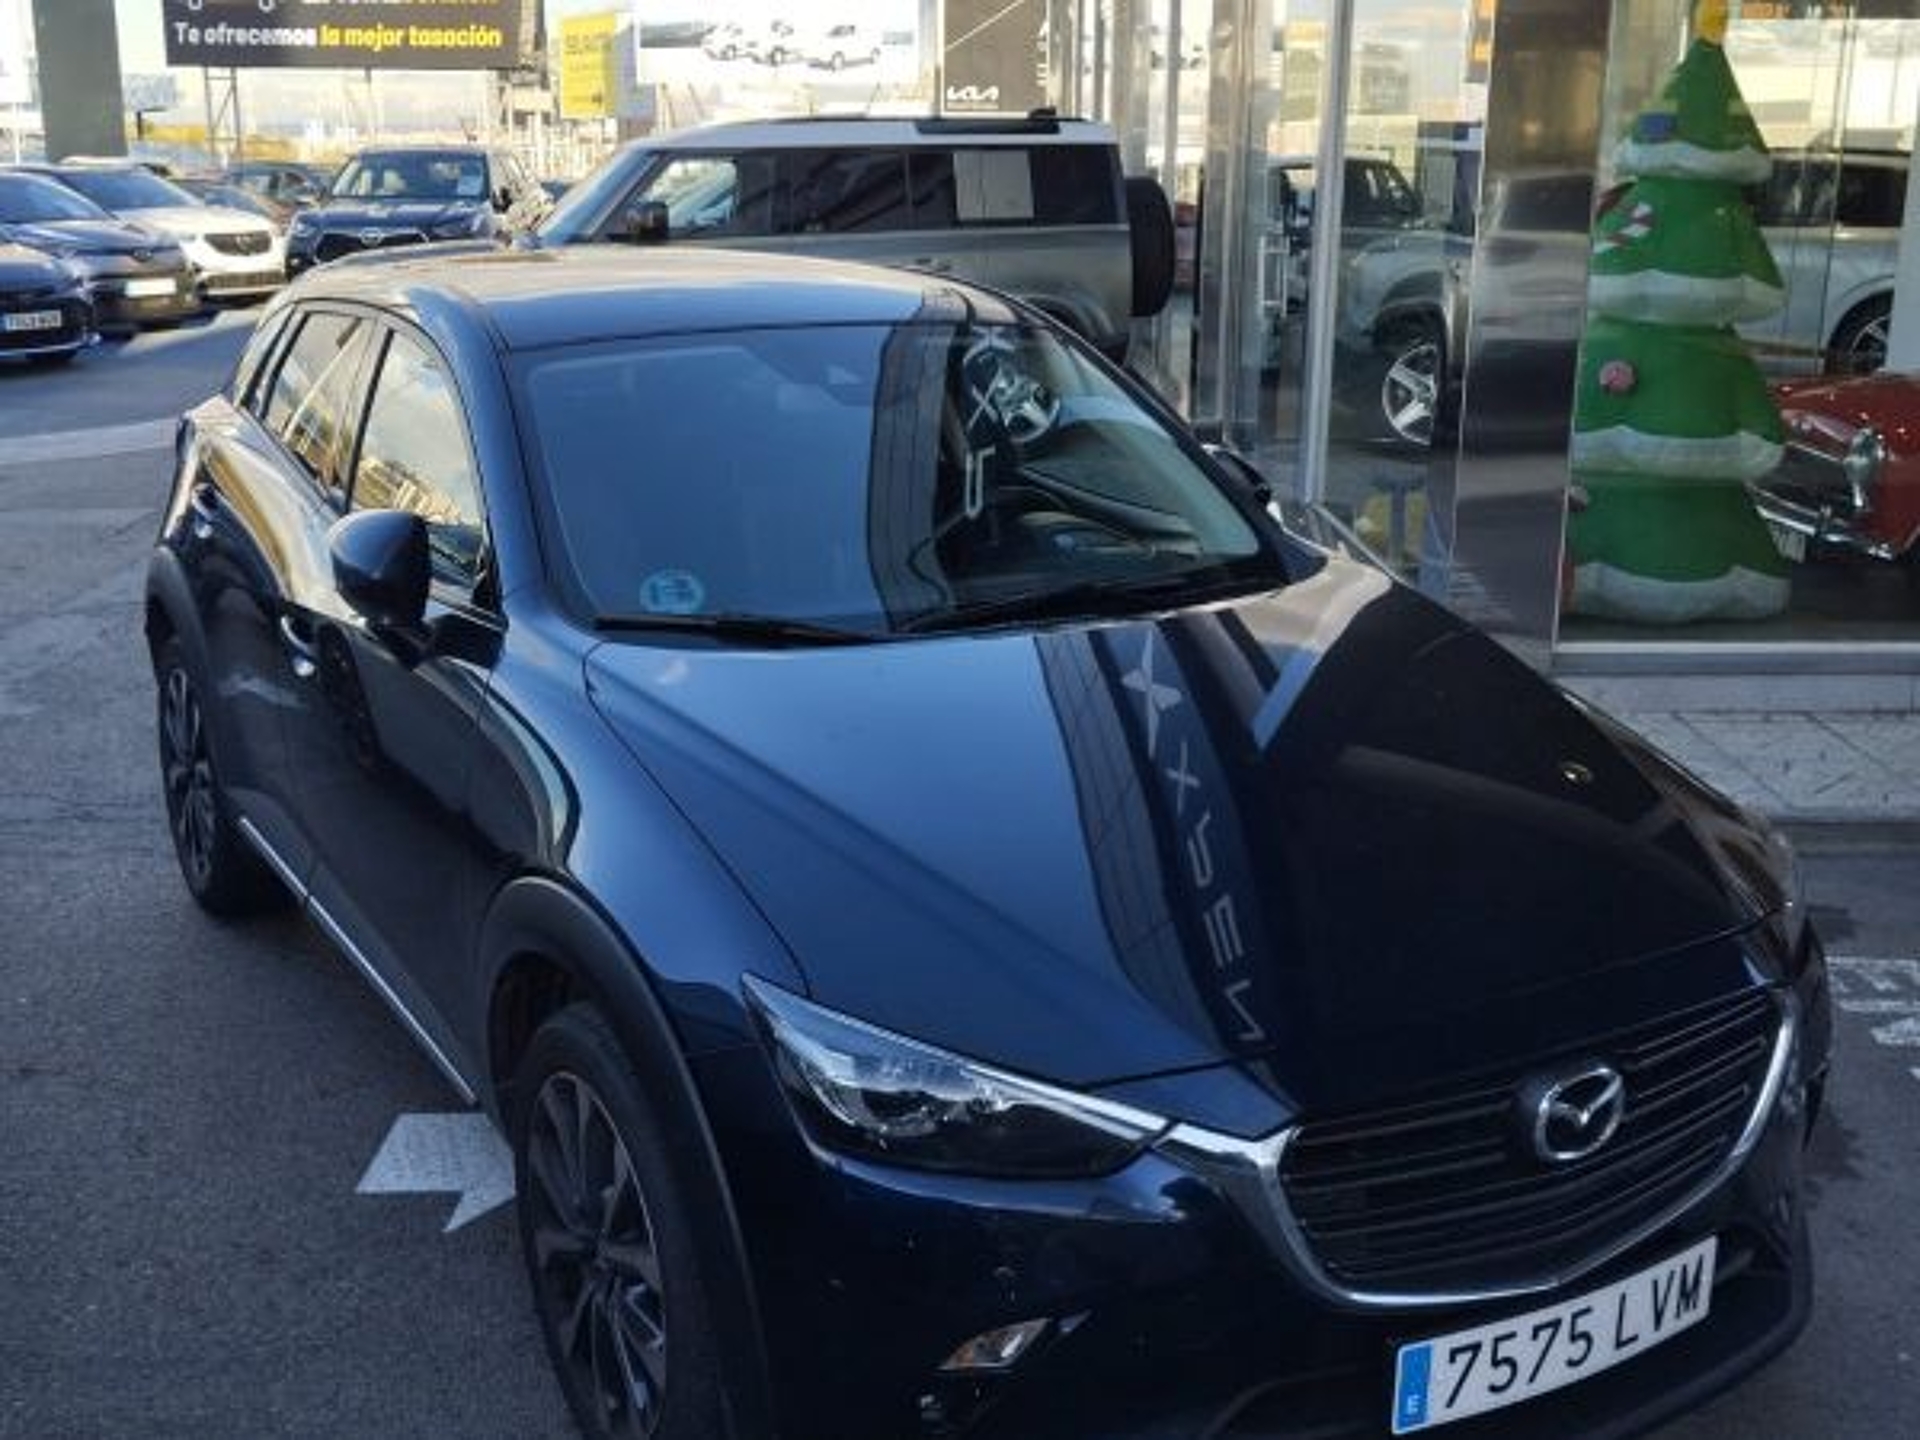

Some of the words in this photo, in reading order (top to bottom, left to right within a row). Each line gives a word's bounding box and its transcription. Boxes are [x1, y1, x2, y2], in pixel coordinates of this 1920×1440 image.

[174, 22, 200, 45] Te
[204, 23, 317, 46] ofrecemos
[320, 24, 340, 46] la
[344, 22, 403, 51] mejor
[408, 24, 502, 47] tasación
[1445, 1306, 1594, 1409] 7575
[1615, 1254, 1704, 1350] LVM
